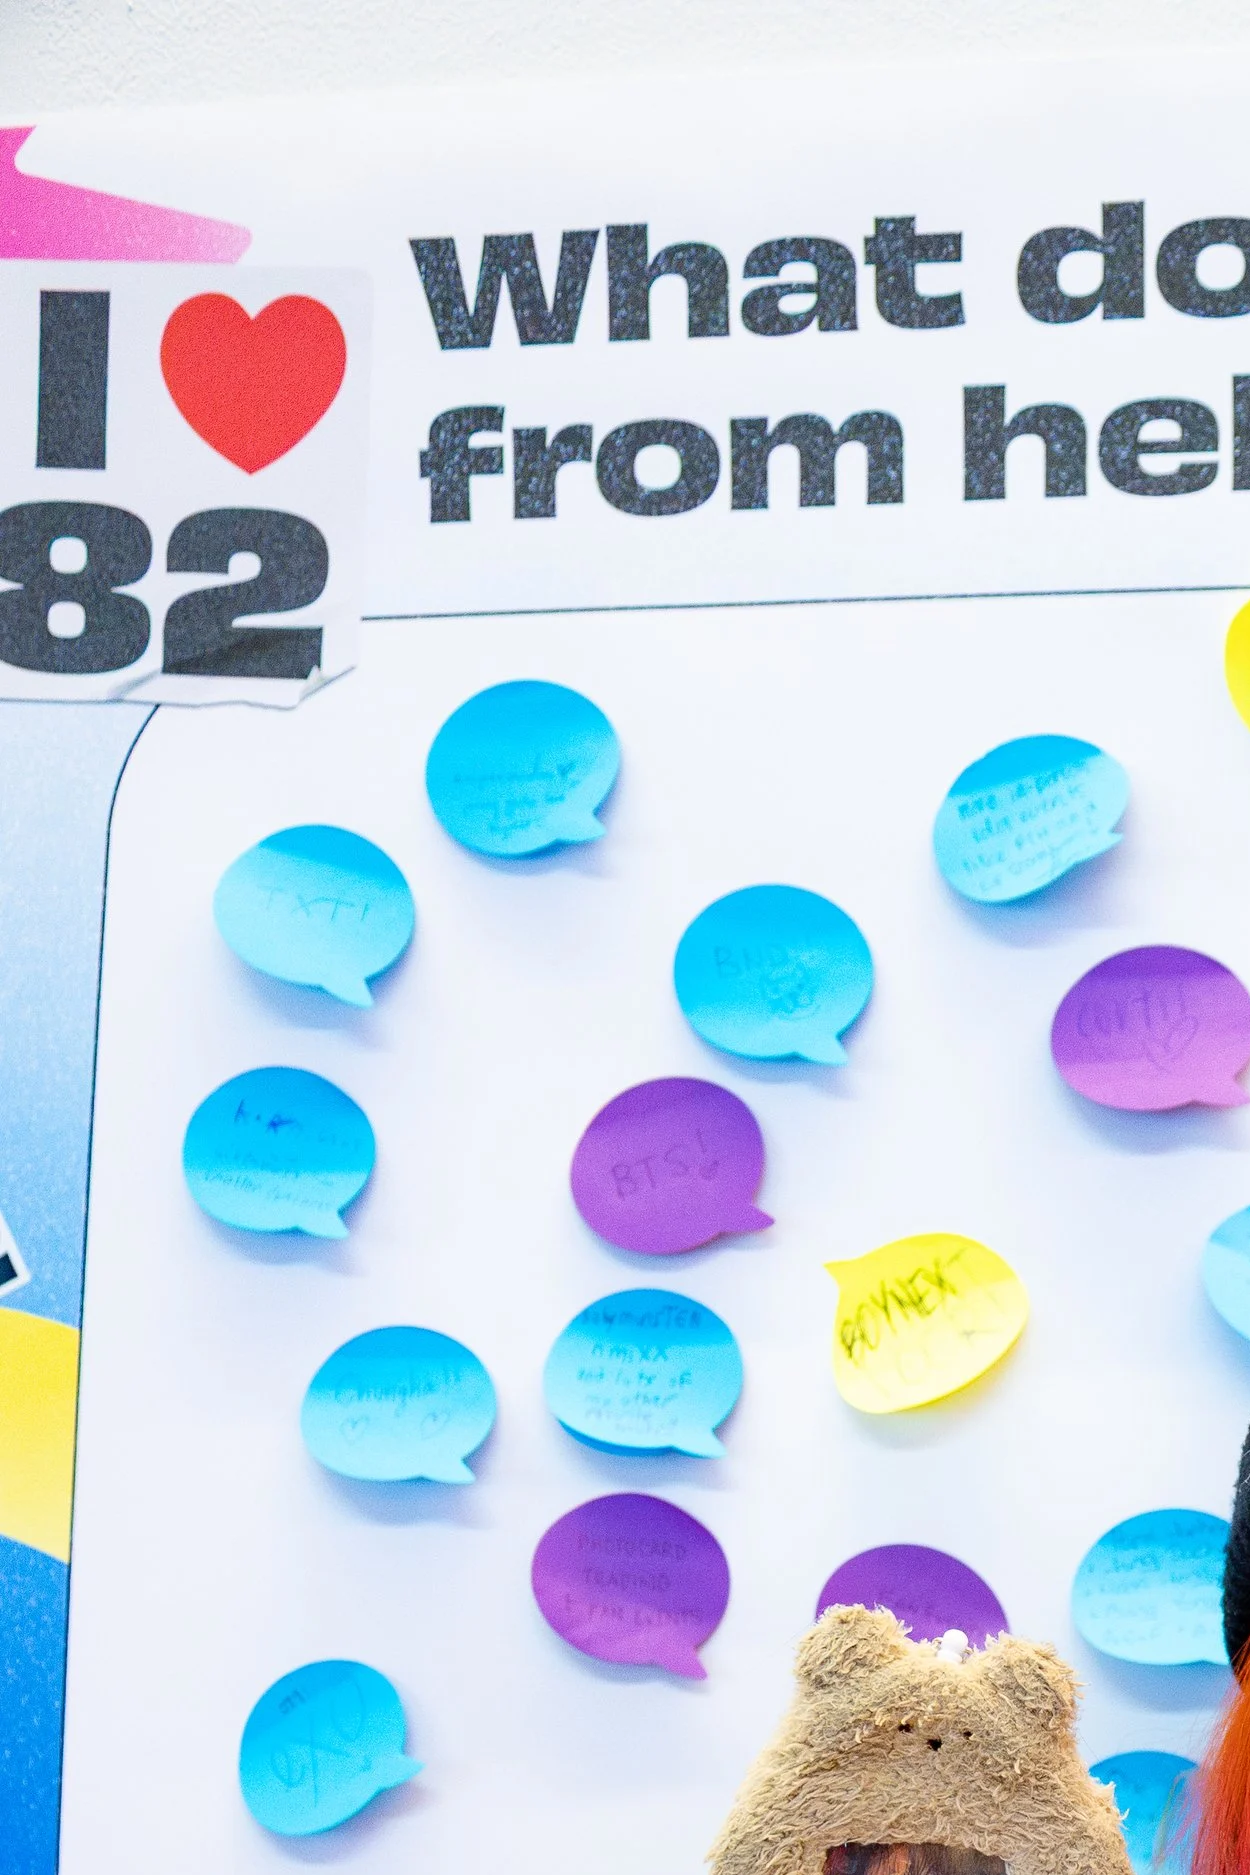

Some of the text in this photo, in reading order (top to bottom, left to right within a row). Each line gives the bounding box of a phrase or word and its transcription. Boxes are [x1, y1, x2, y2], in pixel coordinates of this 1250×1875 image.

[409, 218, 963, 350] What
[36, 290, 110, 470] I
[419, 406, 902, 523] from
[0, 501, 329, 680] 82
